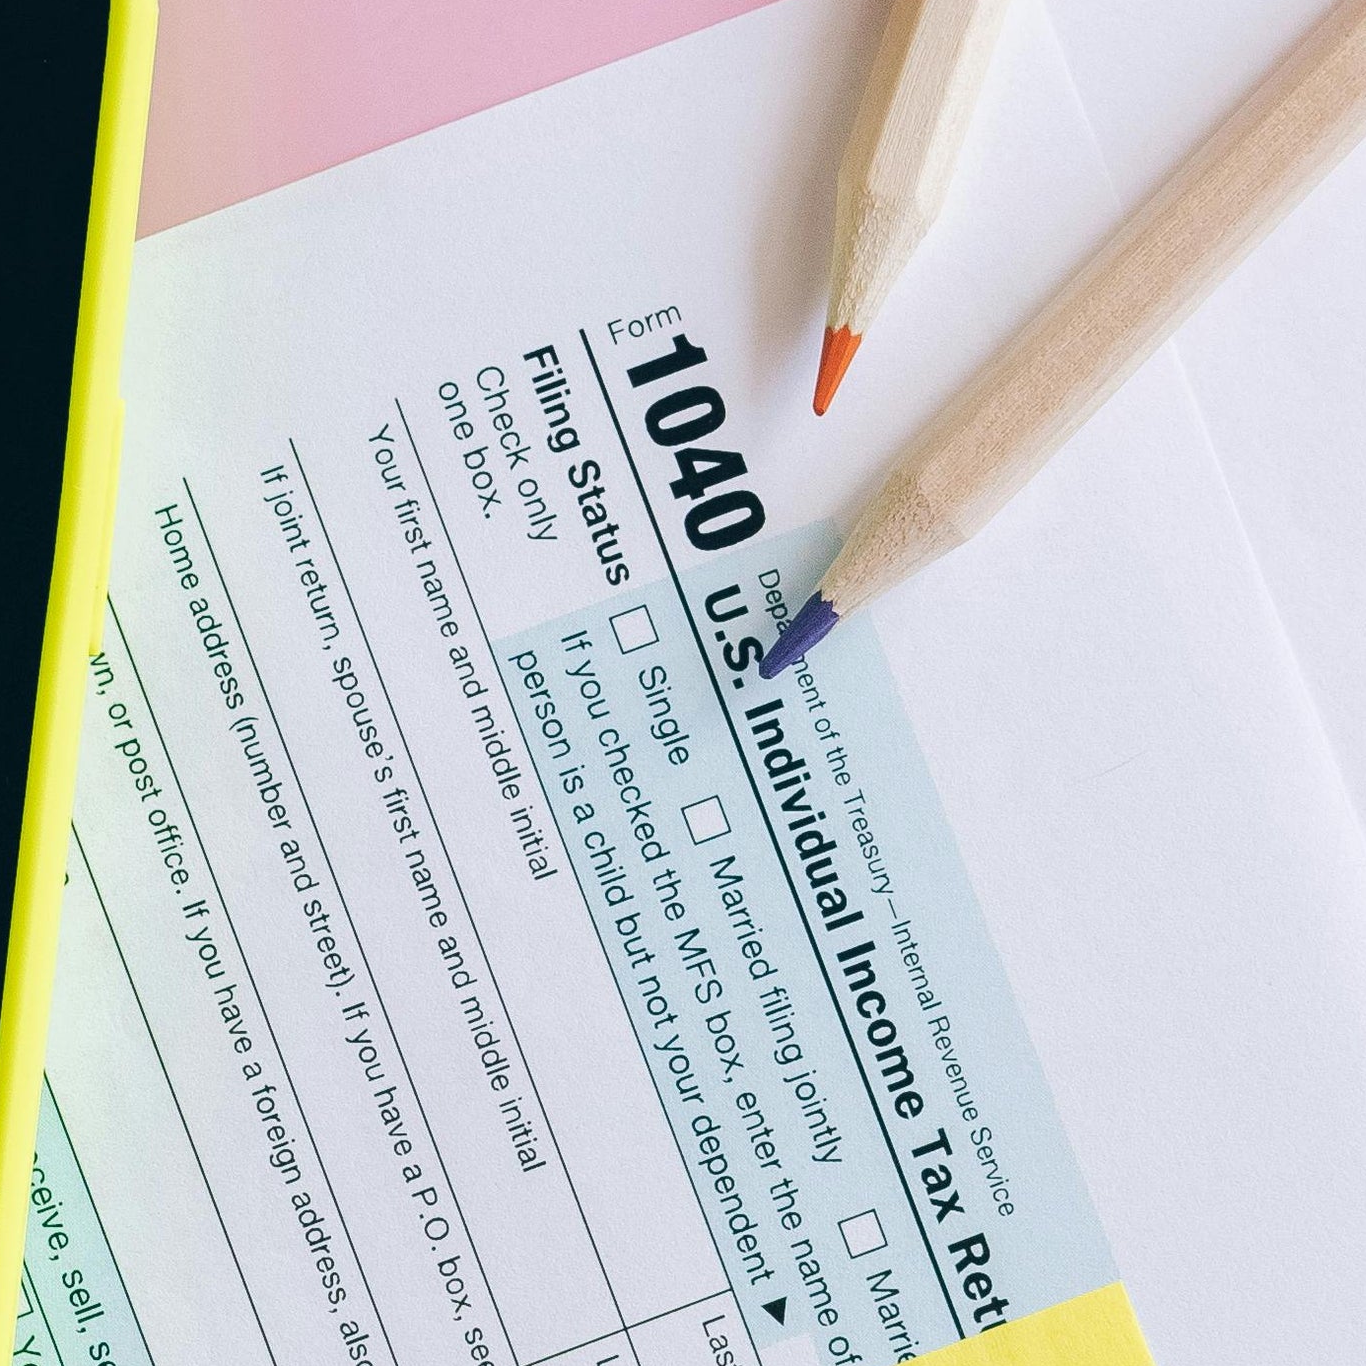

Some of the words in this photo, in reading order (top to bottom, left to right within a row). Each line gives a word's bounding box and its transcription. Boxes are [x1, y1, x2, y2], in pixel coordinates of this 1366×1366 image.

[606, 305, 681, 345] Form
[259, 464, 288, 483] If
[437, 381, 474, 441] one
[462, 445, 502, 519] box.
[476, 365, 531, 471] Check
[517, 477, 558, 540] only
[522, 343, 581, 453] Filing
[567, 458, 630, 586] Status
[625, 332, 766, 551] 1040
[154, 503, 199, 590] Home
[262, 489, 310, 553] joint
[294, 557, 340, 650] return,
[560, 629, 593, 652] If
[188, 597, 244, 710] address
[368, 422, 406, 491] Your
[394, 498, 432, 554] first
[415, 559, 459, 637] name
[448, 645, 489, 699] and
[470, 704, 521, 800] middle
[509, 804, 558, 881] initial
[564, 658, 610, 720] you
[507, 649, 571, 759] person
[637, 665, 689, 766] Single
[813, 717, 840, 741] of
[228, 716, 292, 829] (number
[558, 763, 585, 794] is
[597, 727, 670, 863] checked
[825, 745, 851, 786] the
[382, 787, 420, 844] first
[572, 802, 595, 824] a
[279, 839, 320, 892] and
[404, 848, 448, 928] name
[583, 830, 634, 907] child
[652, 867, 686, 921] the
[702, 582, 765, 691] U.S.
[743, 697, 865, 932] Individual
[835, 939, 924, 1120] Income
[910, 1127, 965, 1224] Tax
[302, 899, 355, 997] street).
[437, 935, 478, 989] and
[614, 911, 656, 969] but
[673, 927, 723, 1004] MFS
[341, 1000, 370, 1021] If
[636, 974, 678, 1030] not
[708, 854, 779, 981] Married
[758, 985, 803, 1065] filing
[781, 1068, 842, 1163] jointly
[344, 1027, 384, 1082] you
[459, 995, 510, 1091] middle
[652, 1033, 705, 1103] your
[704, 1009, 745, 1083] box,
[927, 1014, 978, 1121] Revenue
[373, 1085, 412, 1156] have
[498, 1096, 546, 1173] initial
[734, 1091, 782, 1169] enter
[401, 1163, 422, 1184] a
[690, 1114, 775, 1286] dependent
[769, 1177, 802, 1230] the
[969, 1126, 1014, 1217] Service
[411, 1186, 450, 1251] P.O.
[436, 1254, 472, 1321] box,
[789, 1238, 838, 1327] name
[827, 1335, 863, 1366] of
